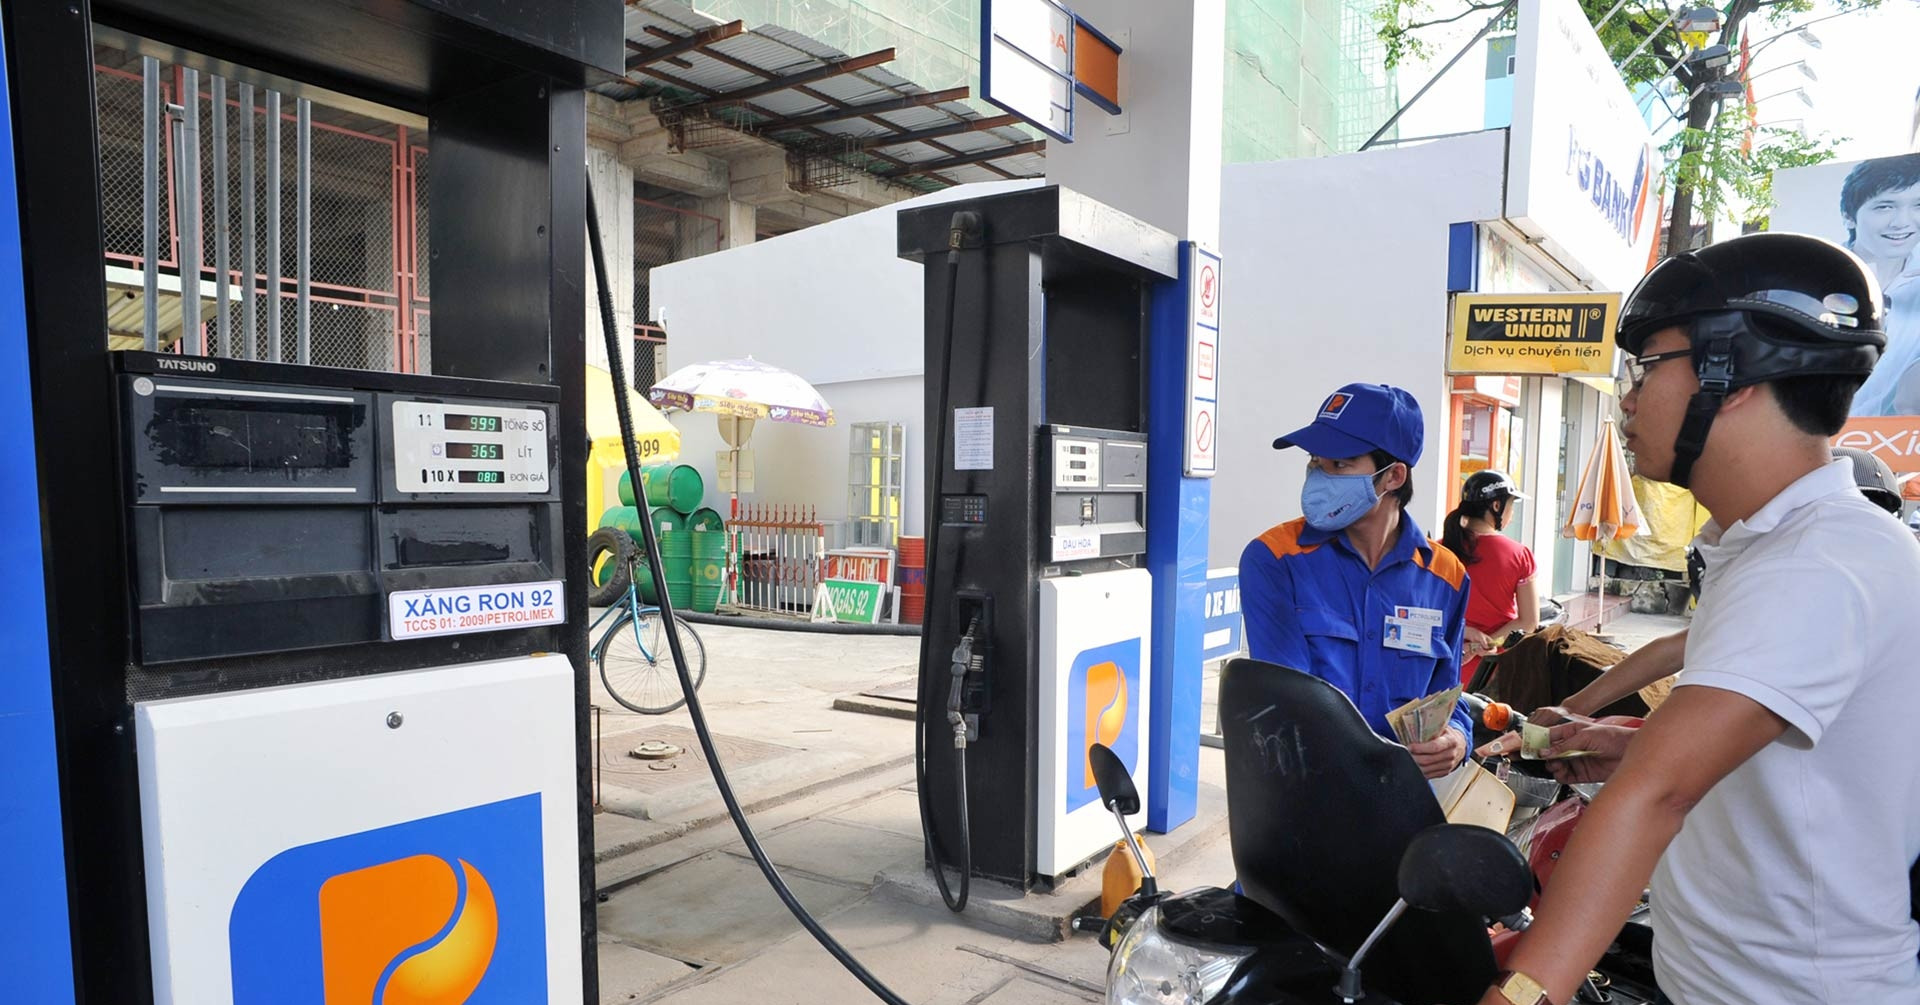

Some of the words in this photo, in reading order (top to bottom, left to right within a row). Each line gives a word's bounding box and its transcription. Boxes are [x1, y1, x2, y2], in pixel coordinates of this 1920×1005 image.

[1592, 156, 1629, 239] BANK
[1474, 308, 1572, 322] WESTERN
[1505, 324, 1571, 338] UNION
[1464, 345, 1493, 357] Dịch
[1498, 347, 1514, 358] vụ
[1518, 344, 1570, 359] chuyển
[157, 359, 216, 372] TATSUNO
[470, 417, 496, 431] 999
[471, 445, 496, 458] 365
[518, 445, 533, 458] LÍT
[477, 472, 498, 482] 080
[405, 593, 471, 617] XĂNG
[479, 591, 524, 612] RON
[531, 589, 553, 607] 92
[856, 590, 869, 616] 92
[1212, 590, 1224, 617] XE
[404, 618, 436, 632] TCCS
[440, 617, 456, 629] 01:
[460, 608, 554, 627] 2009/PETROLIMEX
